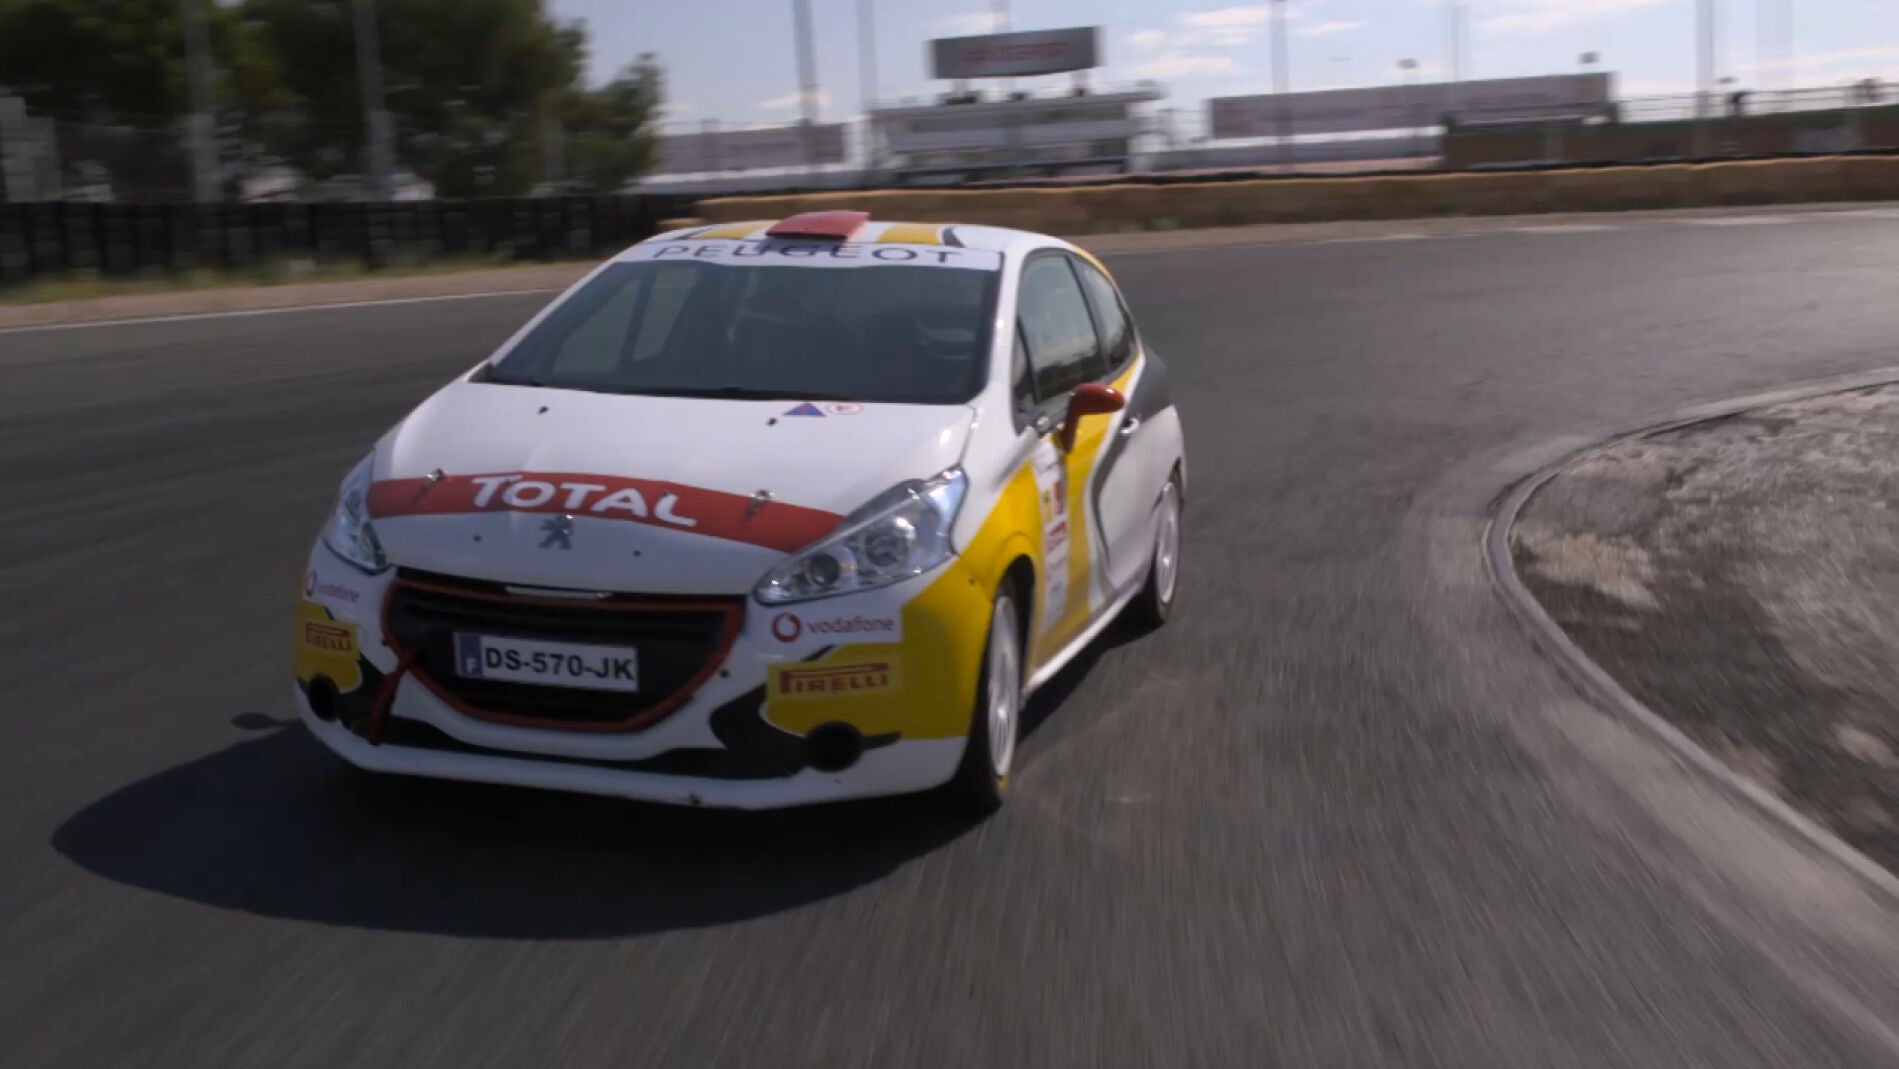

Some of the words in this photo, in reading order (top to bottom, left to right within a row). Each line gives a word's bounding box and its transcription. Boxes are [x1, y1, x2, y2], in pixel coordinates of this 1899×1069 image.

[652, 244, 962, 264] PEUGEOT
[471, 475, 697, 527] TOTAL
[306, 622, 353, 651] PIRELLI
[807, 615, 896, 633] vodafone
[464, 656, 478, 674] F
[485, 647, 635, 680] DS-570-JK
[779, 662, 890, 694] PIRELLI
